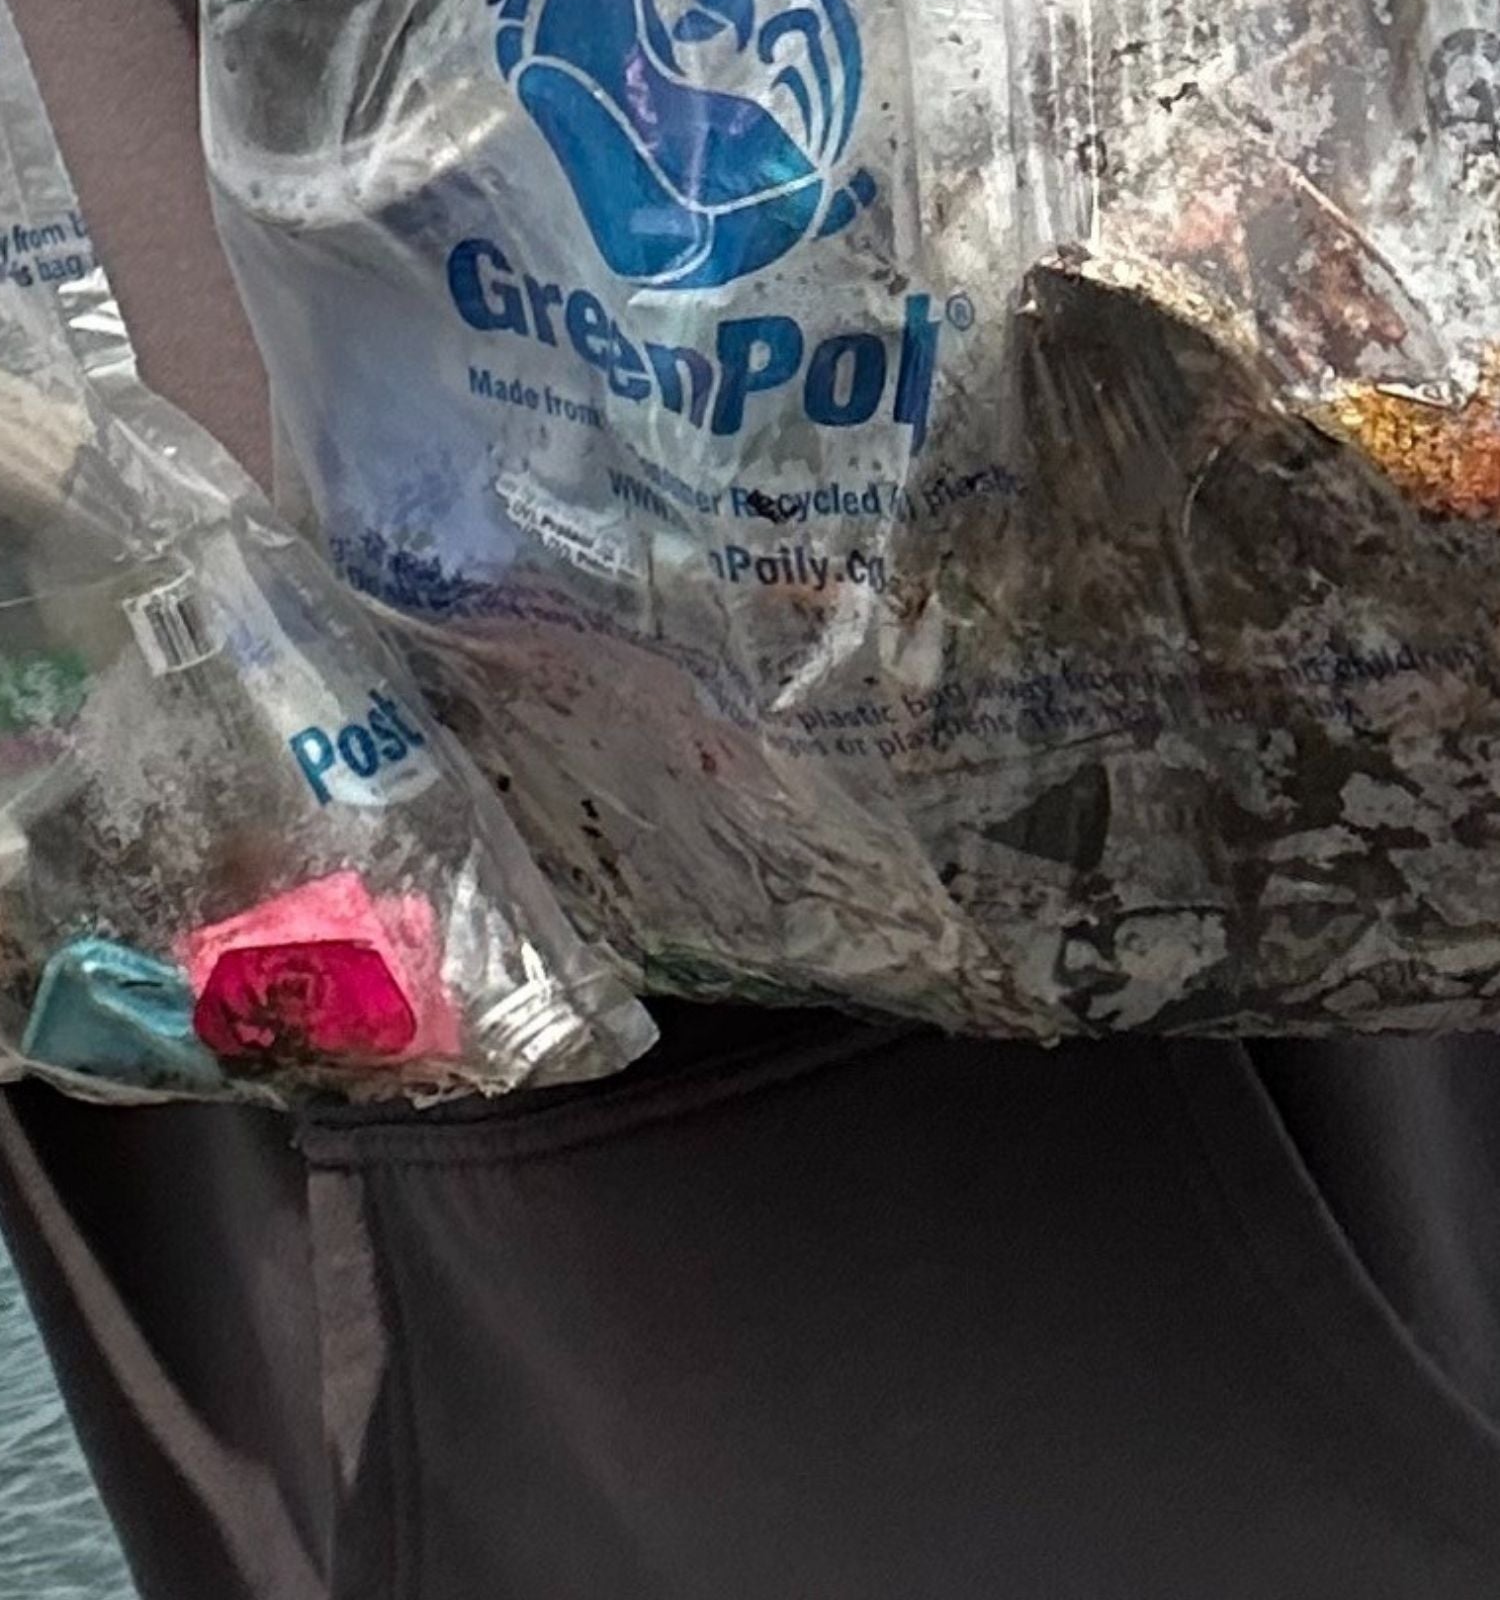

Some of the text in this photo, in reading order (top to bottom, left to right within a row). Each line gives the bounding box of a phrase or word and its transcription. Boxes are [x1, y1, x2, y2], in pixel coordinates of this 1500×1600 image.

[12, 223, 65, 255] from
[469, 365, 541, 409] Made
[289, 688, 426, 807] Post
